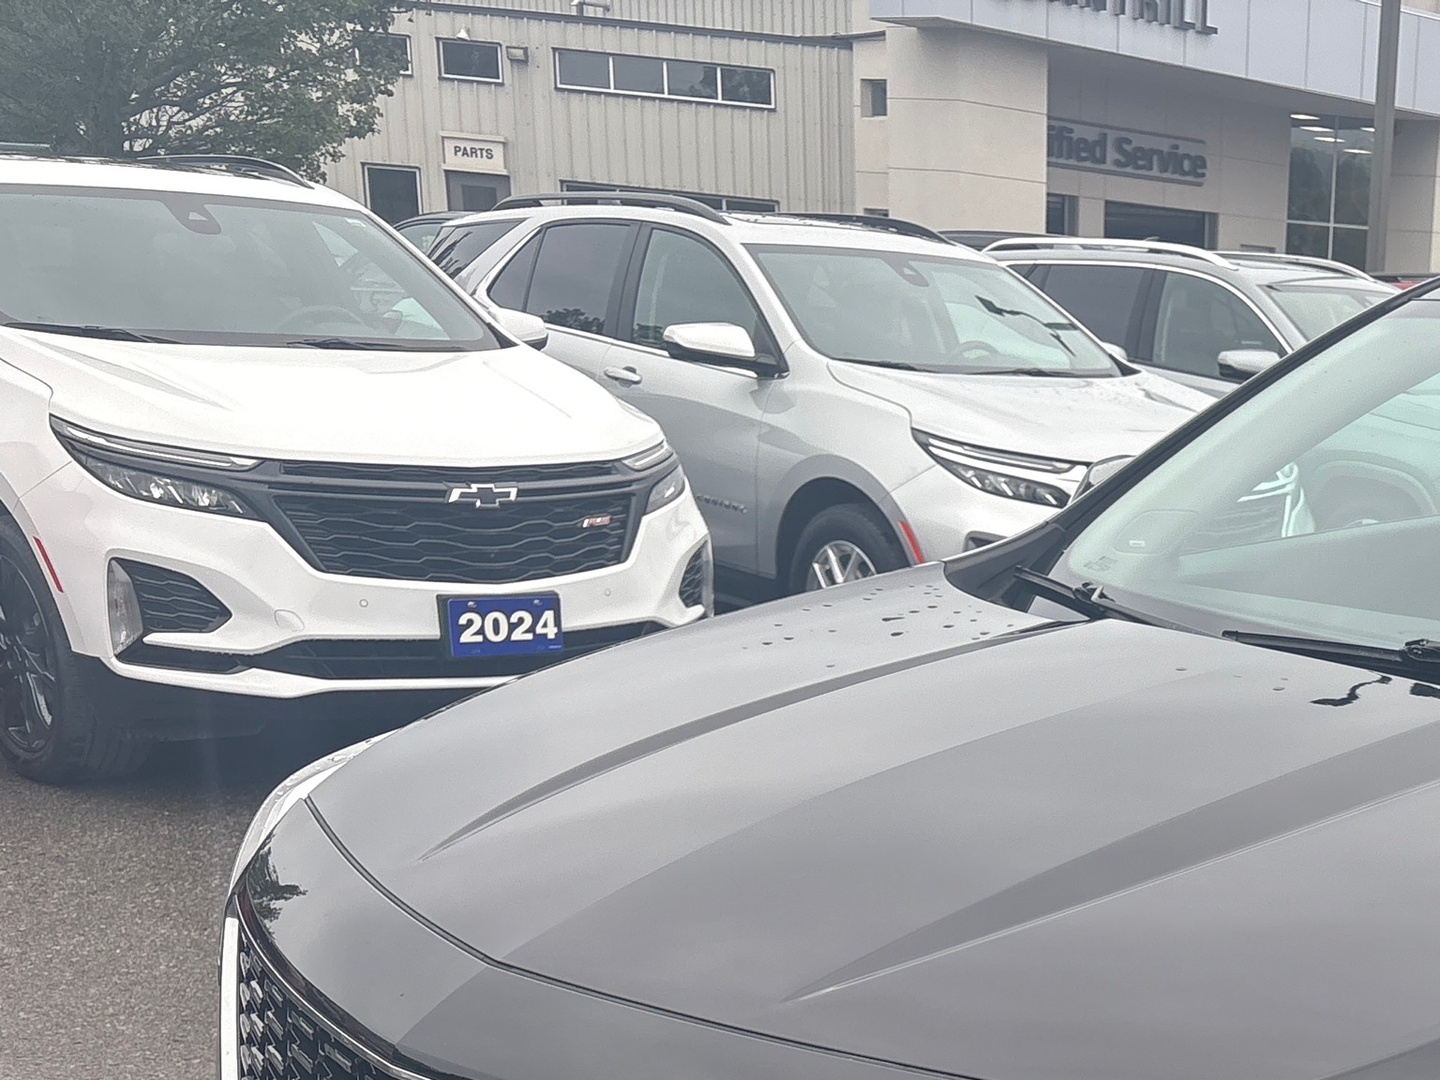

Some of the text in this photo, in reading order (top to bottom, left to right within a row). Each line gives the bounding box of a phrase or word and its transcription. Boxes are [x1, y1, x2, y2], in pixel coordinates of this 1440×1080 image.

[453, 145, 494, 159] PARTS
[1113, 136, 1207, 178] Service
[458, 610, 558, 643] 2024
